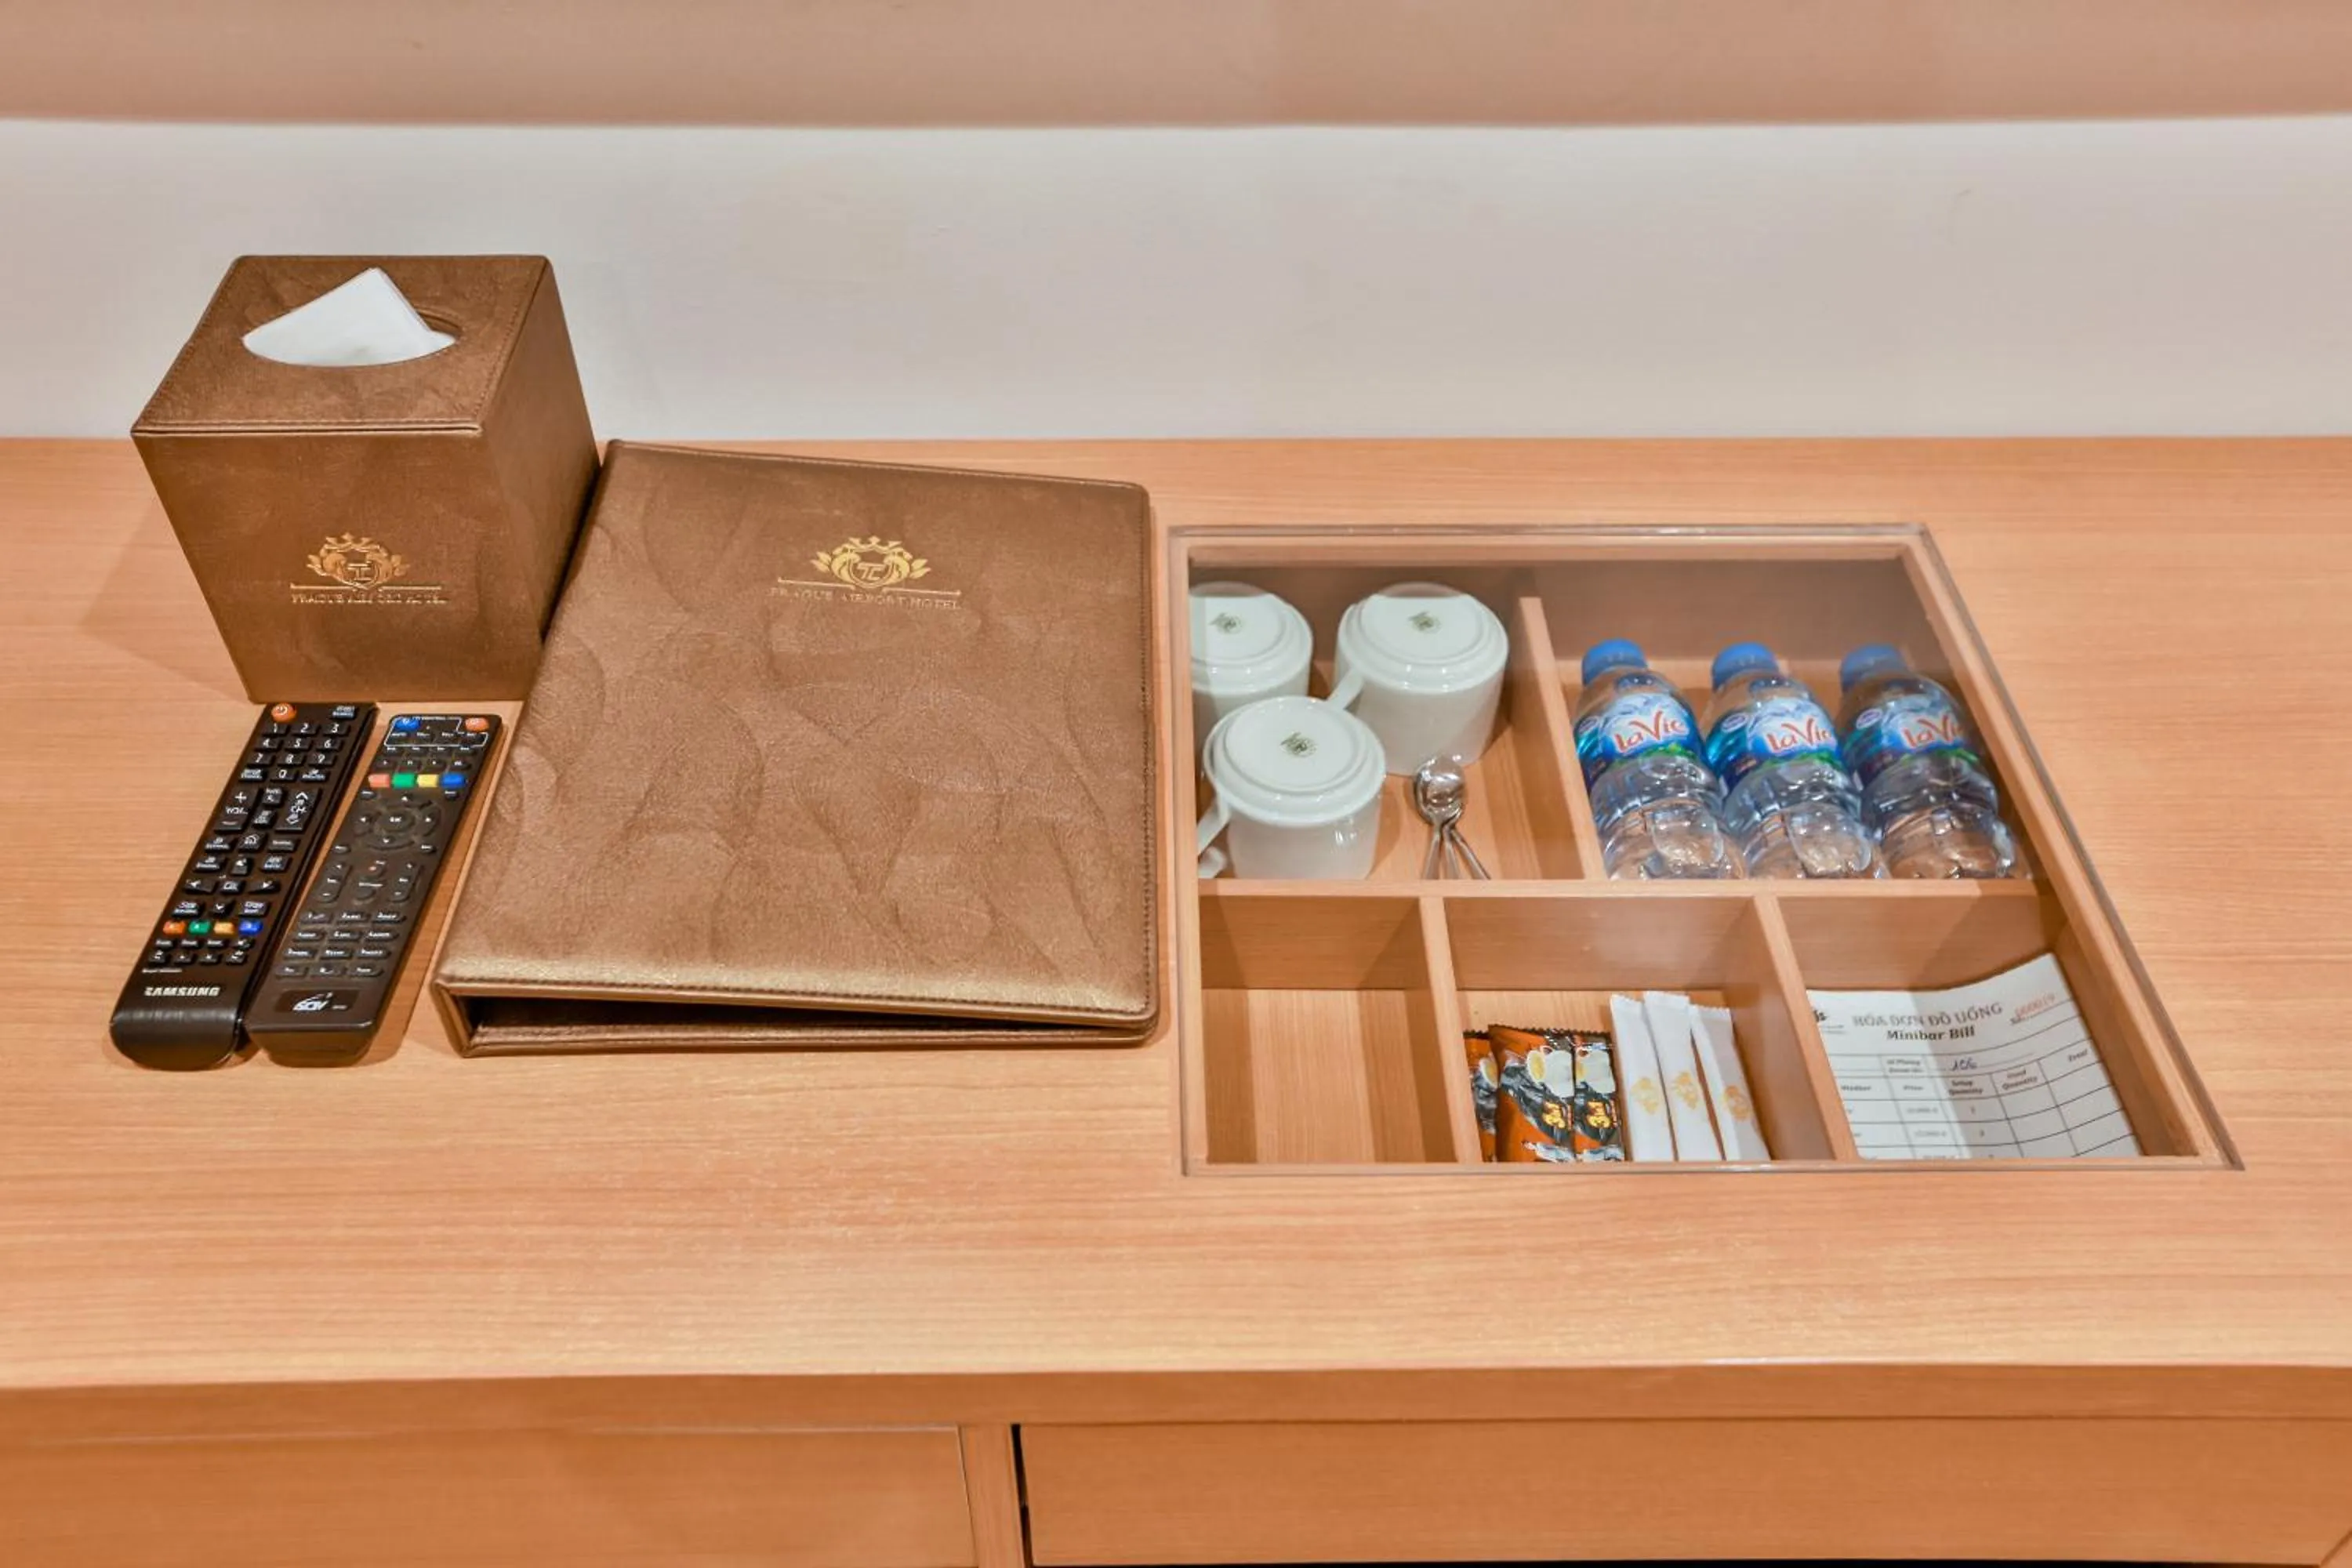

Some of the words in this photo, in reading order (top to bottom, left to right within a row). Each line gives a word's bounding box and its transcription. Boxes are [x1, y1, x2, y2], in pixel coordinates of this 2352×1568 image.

[300, 723, 310, 733] 2
[332, 723, 339, 733] 3
[263, 738, 270, 747] 4
[294, 738, 302, 748] 5
[324, 739, 332, 748] 6
[255, 753, 263, 764] 7
[285, 753, 294, 764] 8
[318, 753, 325, 764] 9
[278, 769, 287, 779] 0
[143, 986, 220, 996] SAMSUNG
[1886, 1029, 1945, 1041] Minibar
[1949, 1025, 1975, 1040] Bill
